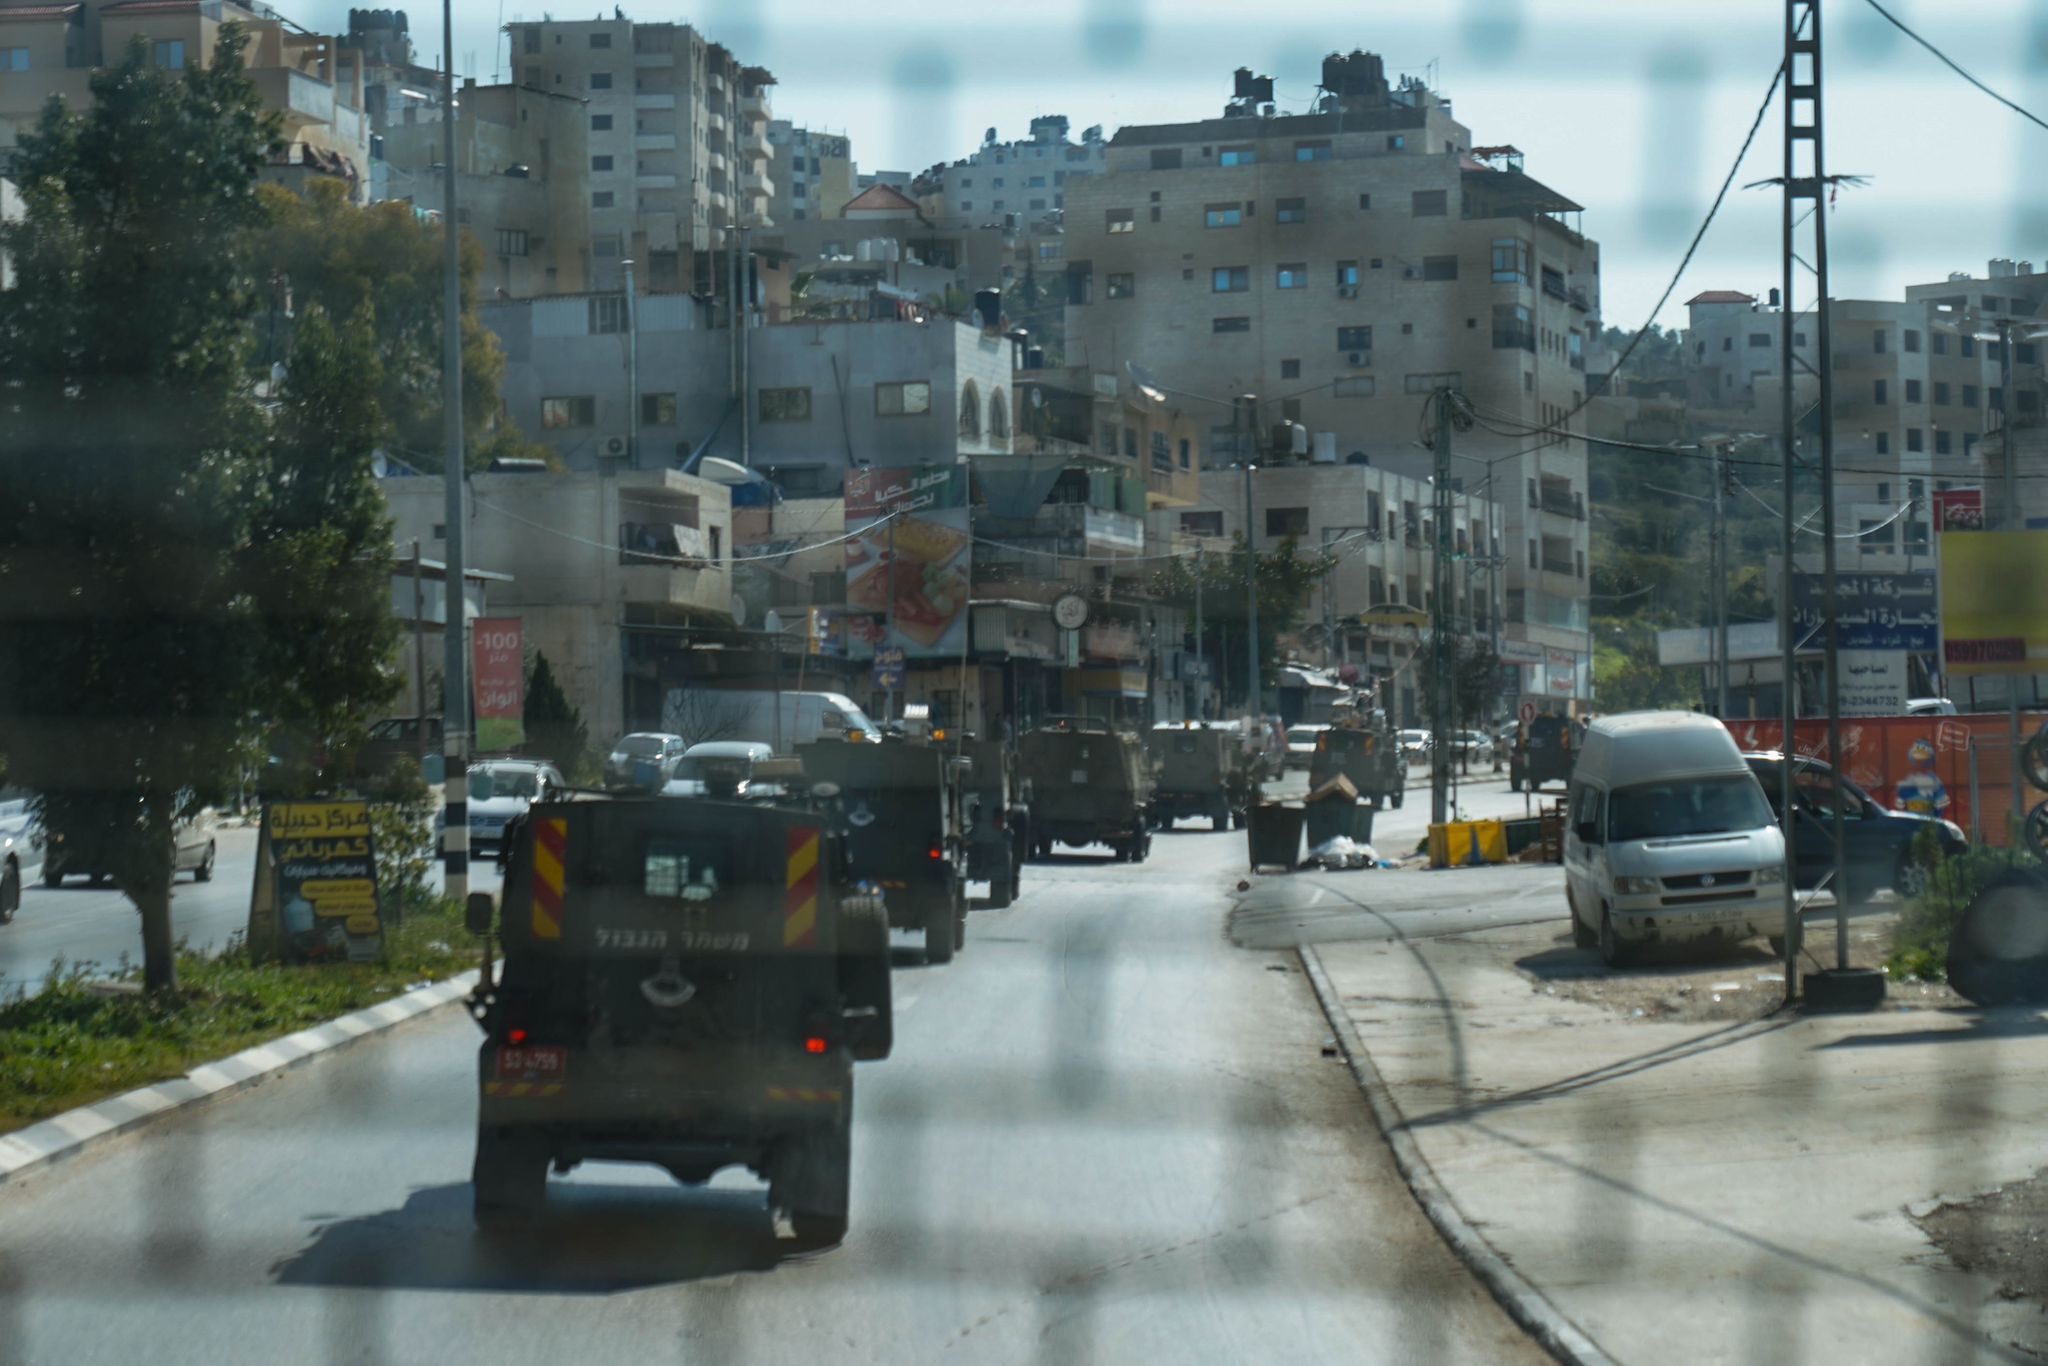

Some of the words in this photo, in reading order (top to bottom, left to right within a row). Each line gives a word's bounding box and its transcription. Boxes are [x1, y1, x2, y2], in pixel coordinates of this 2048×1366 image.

[1871, 578, 1933, 600] شركة
[1879, 607, 1938, 629] تجارة
[326, 808, 369, 830] مركز
[594, 927, 667, 949] הגבול
[680, 930, 750, 951] משמר
